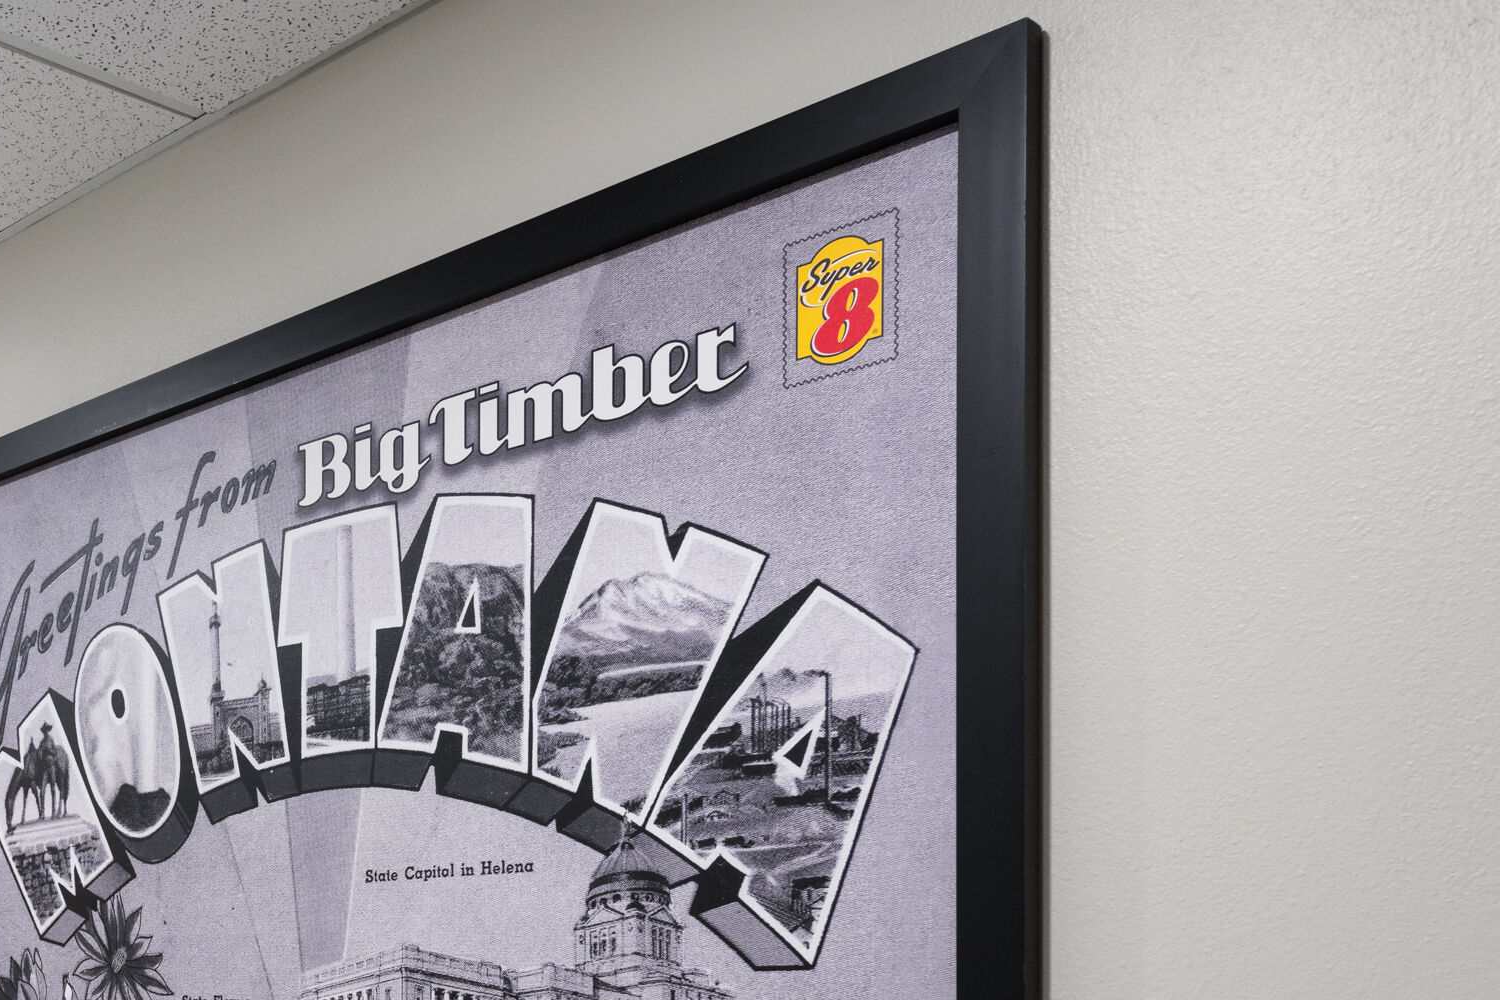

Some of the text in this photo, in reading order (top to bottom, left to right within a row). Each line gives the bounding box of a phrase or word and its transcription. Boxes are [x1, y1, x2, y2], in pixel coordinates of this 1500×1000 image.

[801, 256, 880, 301] Super
[810, 277, 880, 357] 8
[166, 451, 277, 580] from
[298, 421, 431, 507] Big
[428, 322, 750, 466] Timber
[365, 860, 534, 883] State Capitol in Helena
